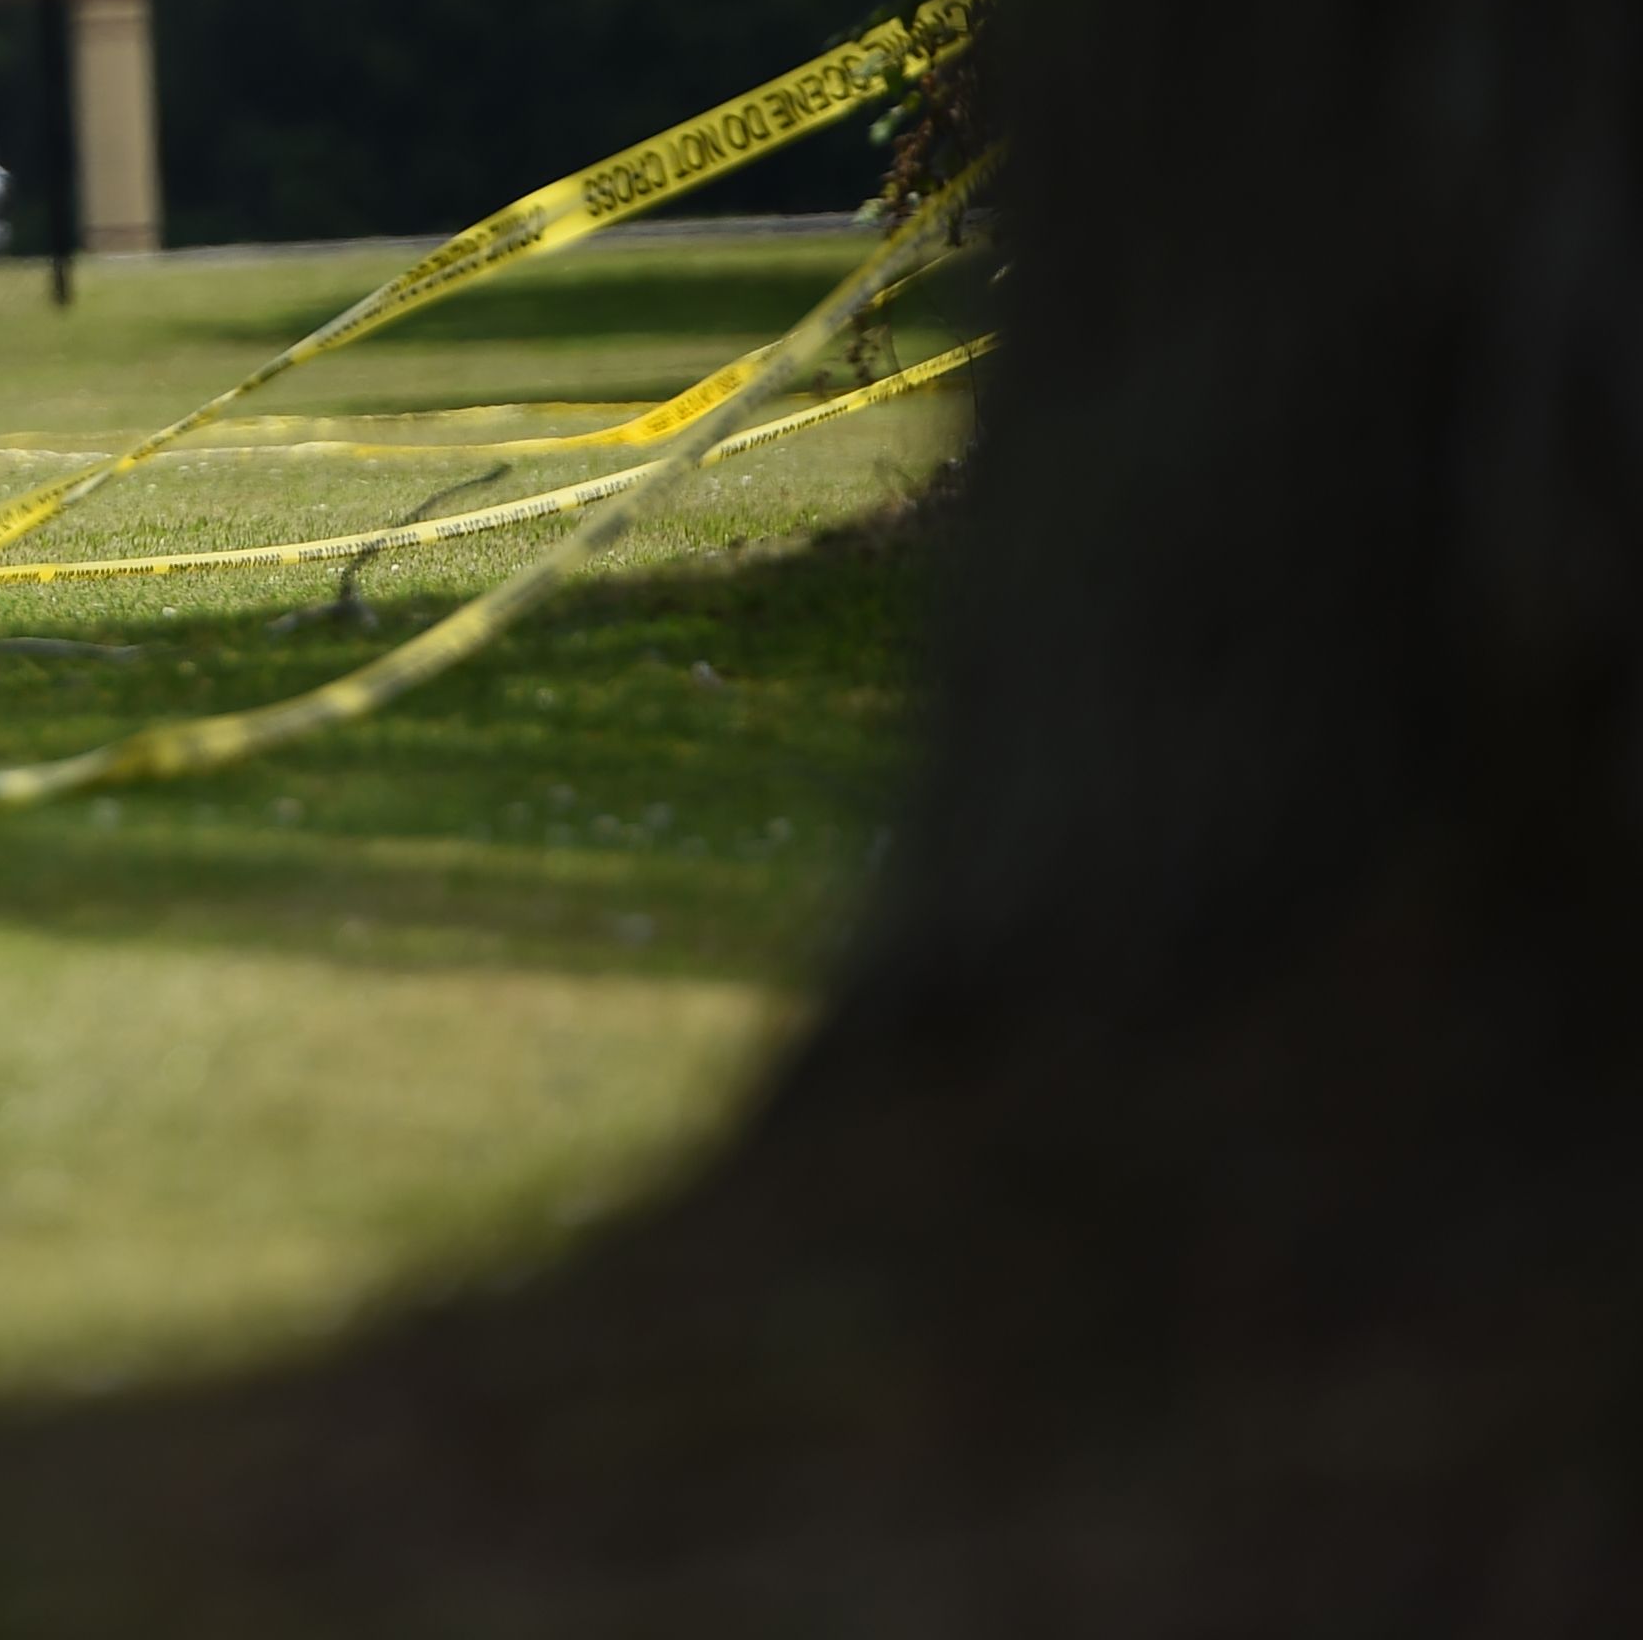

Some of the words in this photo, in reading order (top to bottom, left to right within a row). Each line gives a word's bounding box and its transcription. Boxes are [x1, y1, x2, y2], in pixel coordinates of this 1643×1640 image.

[723, 102, 770, 152] DO
[671, 131, 727, 180] NOT
[583, 151, 666, 216] CROSS
